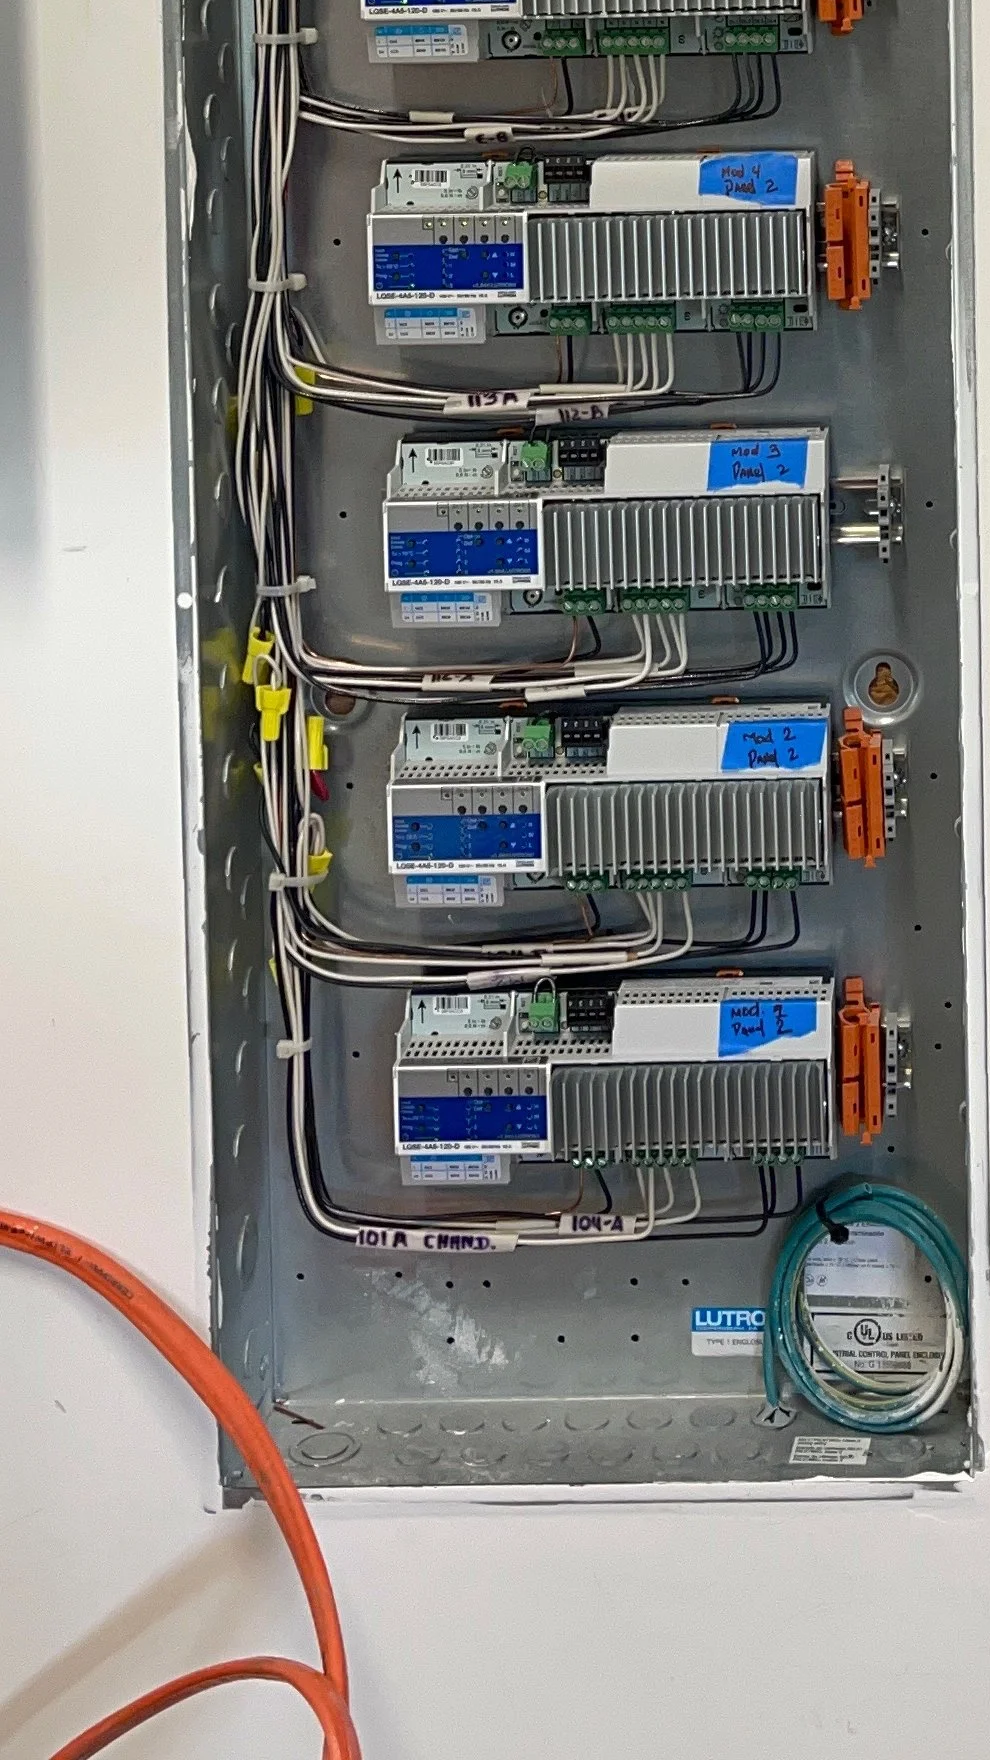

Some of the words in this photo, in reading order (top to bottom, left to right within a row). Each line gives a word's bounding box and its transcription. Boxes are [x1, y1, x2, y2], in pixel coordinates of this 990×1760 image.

[752, 163, 761, 179] 4
[766, 178, 780, 194] 2
[767, 443, 781, 459] 3
[776, 464, 791, 476] 2
[784, 726, 796, 740] 2
[788, 747, 799, 761] 2
[776, 1019, 793, 1036] 2
[695, 1310, 766, 1326] LUTRO
